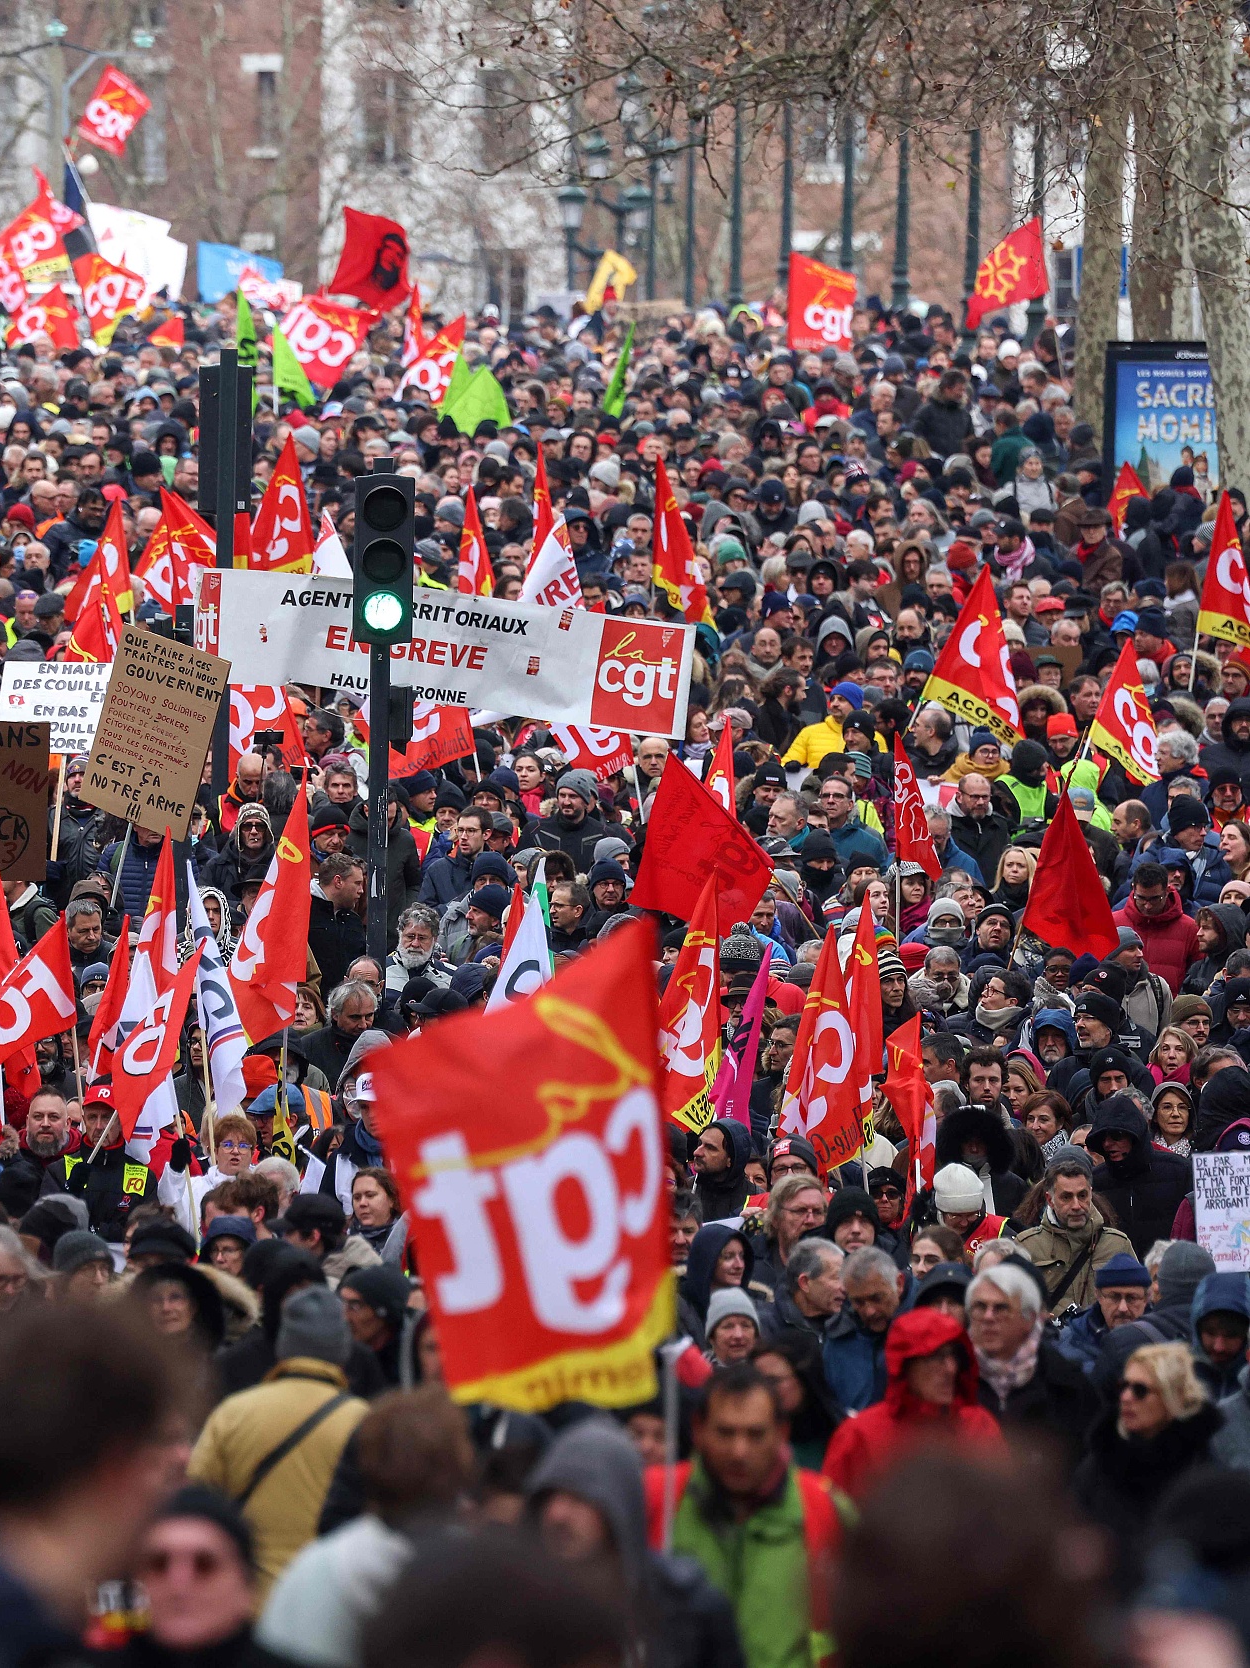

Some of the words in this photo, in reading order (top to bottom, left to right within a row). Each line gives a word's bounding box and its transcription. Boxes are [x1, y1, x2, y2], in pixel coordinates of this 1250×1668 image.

[85, 98, 134, 142] cgt
[803, 303, 854, 342] cgt
[1137, 410, 1217, 443] MOMI
[281, 590, 354, 608] AGENT
[124, 633, 149, 649] QUE
[188, 653, 195, 665] À
[195, 660, 213, 672] CES
[377, 653, 383, 661] 2
[390, 638, 488, 670] GREVE
[604, 631, 677, 665] la
[38, 663, 59, 675] EN
[62, 663, 107, 676] HAUT
[123, 647, 176, 670] TRAÎTRES
[195, 671, 218, 686] NOUS
[12, 679, 42, 690] DES
[114, 681, 157, 705] SOYONS
[125, 663, 222, 703] GOUVERNENT
[598, 657, 675, 707] cgt
[33, 705, 55, 716] EN
[57, 706, 89, 717] BAS
[108, 707, 136, 723] FORCES
[138, 719, 149, 728] DE
[946, 691, 1016, 739] ACOSS
[155, 712, 190, 735] DOCKERS,
[103, 728, 123, 741] TOUS
[126, 738, 140, 748] LES
[2, 760, 49, 794] NON
[95, 754, 136, 777] C'EST
[139, 771, 161, 788] ÇA
[90, 772, 142, 801] NOTRE
[146, 793, 186, 817] ARME
[98, 1088, 111, 1098] FO
[1196, 1158, 1207, 1168] DE
[1214, 1156, 1231, 1167] PAR
[1196, 1167, 1235, 1178] TALENTS
[126, 1177, 144, 1192] FO
[1196, 1179, 1207, 1189] ET
[1210, 1178, 1225, 1188] MA
[1230, 1175, 1250, 1186] FORT
[1196, 1188, 1227, 1200] J'EUSSE
[1231, 1187, 1242, 1197] PU
